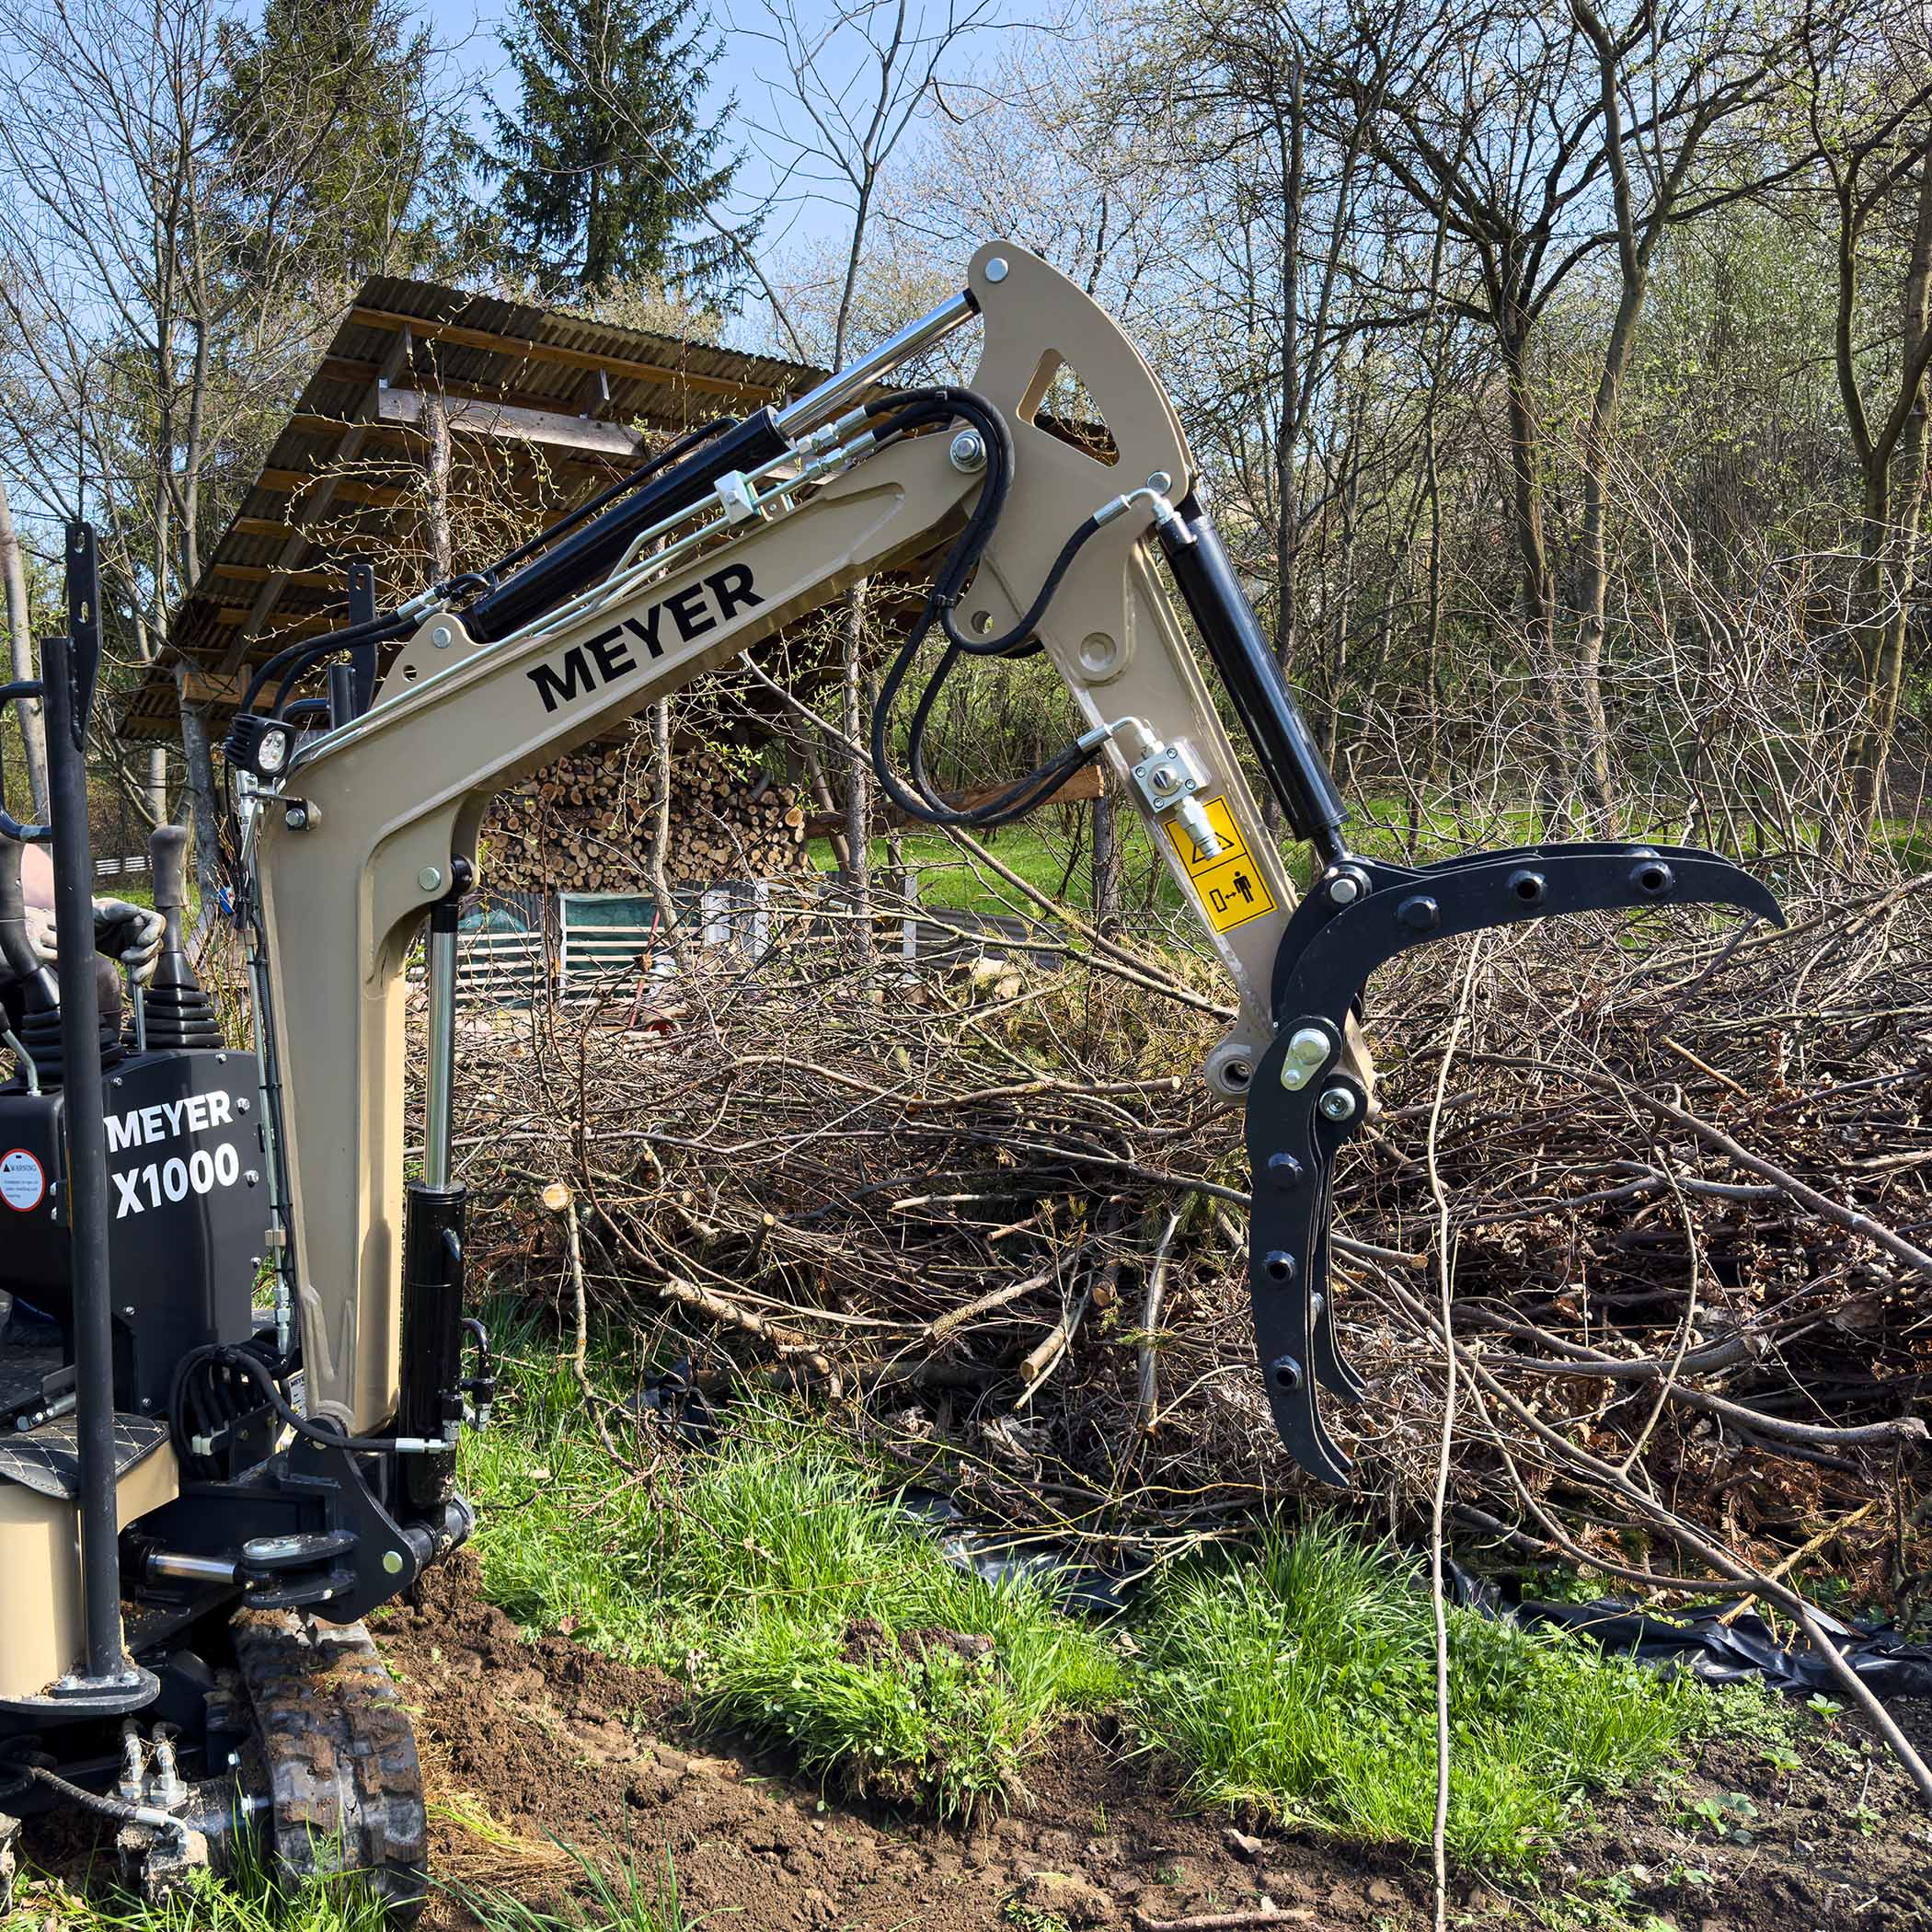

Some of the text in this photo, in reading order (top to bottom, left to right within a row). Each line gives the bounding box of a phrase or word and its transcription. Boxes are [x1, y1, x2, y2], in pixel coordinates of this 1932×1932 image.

[527, 563, 765, 713] MEYER
[103, 1090, 234, 1153] MEYER
[111, 1143, 239, 1219] X1000
